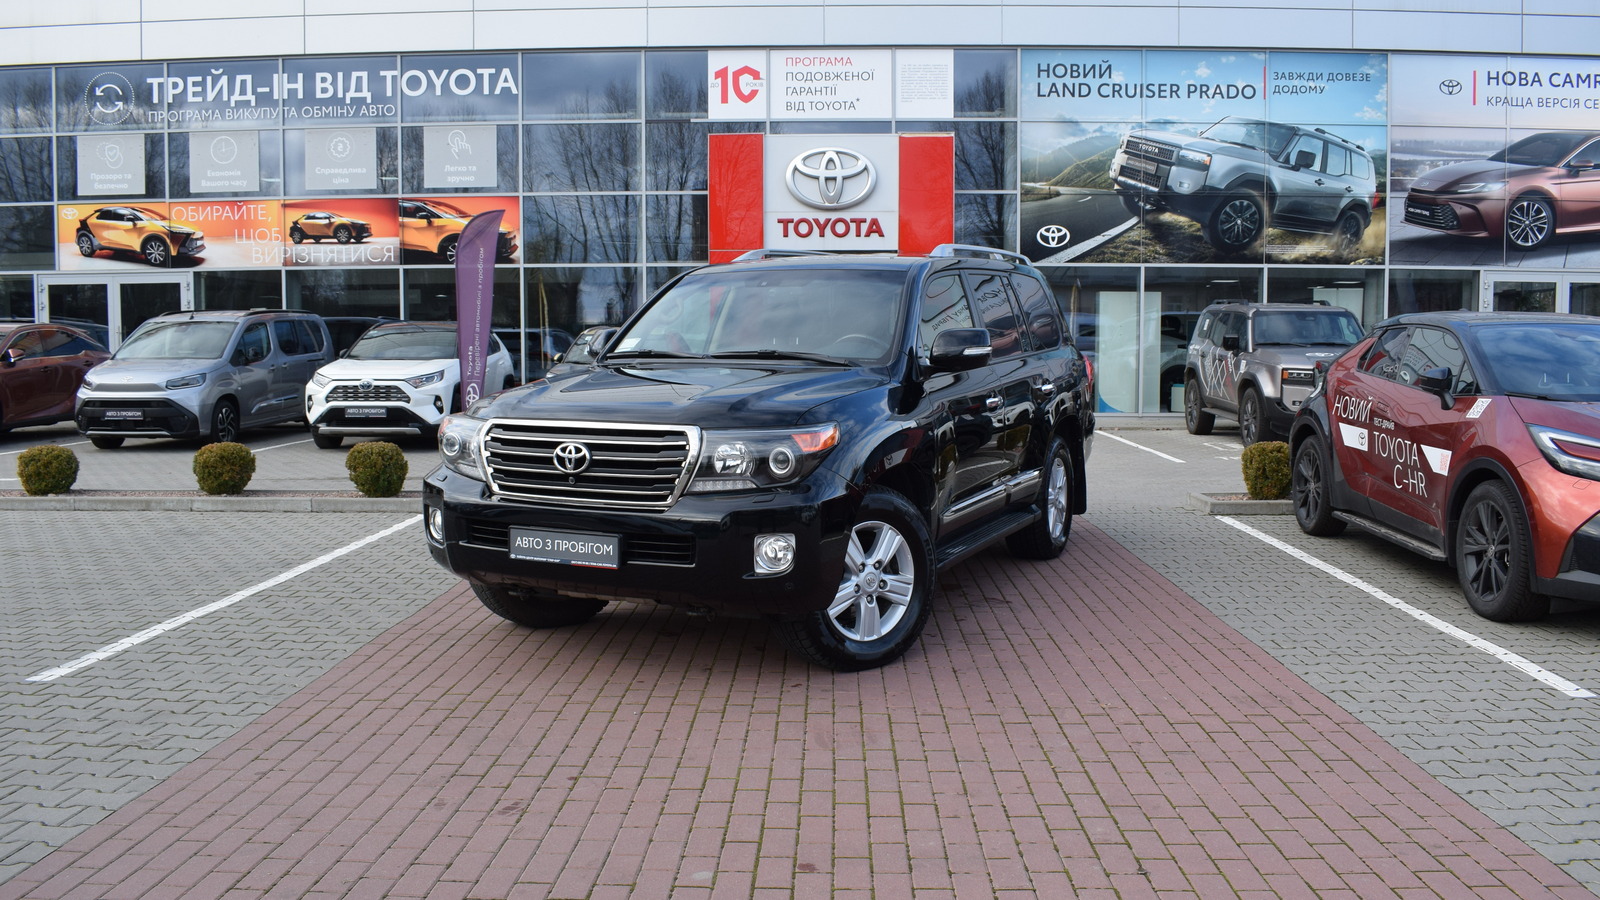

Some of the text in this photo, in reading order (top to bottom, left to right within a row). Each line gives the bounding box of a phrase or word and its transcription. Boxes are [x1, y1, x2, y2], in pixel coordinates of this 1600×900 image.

[785, 56, 853, 67] ПРОГРАМА
[785, 69, 874, 83] ПОДОВЖЕНОЇ
[1036, 59, 1112, 79] НОВИЙ
[1273, 71, 1371, 83] ЗАВЖДИ ДОВЕЗЕ
[1487, 70, 1543, 87] НОВА
[146, 67, 519, 107] ТРЕЙД-ІН ВІД TOYOTA
[785, 84, 838, 97] ГАРАНТІЇ
[1036, 82, 1257, 99] LAND CRUISER PRADO
[1272, 84, 1326, 96] ДОДОМУ
[785, 100, 806, 112] ВІД
[1486, 96, 1534, 110] КРАЩА
[1537, 97, 1580, 109] ВЕРСІЯ
[148, 104, 396, 123] ПРОГРАМА ВИКУПУ ТА ОБМІНУ АВТО
[207, 169, 241, 177] Економія
[315, 167, 367, 176] Справедлива
[444, 165, 467, 173] Легко
[90, 173, 122, 182] Прозоро
[201, 179, 248, 188] Вашого часу
[332, 177, 350, 185] ціна
[447, 175, 475, 184] зручно
[94, 182, 128, 190] безпечно
[172, 202, 272, 223] ОБИРАЙТЕ,
[777, 217, 885, 238] TOYOTA
[235, 228, 282, 245] ЩОБ
[252, 245, 395, 265] ВИРІЗНЯТИСЯ
[1332, 394, 1373, 424] НОВИЙ
[1373, 431, 1420, 468] TOYOTA
[1393, 464, 1428, 498] C-HR
[515, 536, 613, 556] АВТО З ПРОБІГОМ
